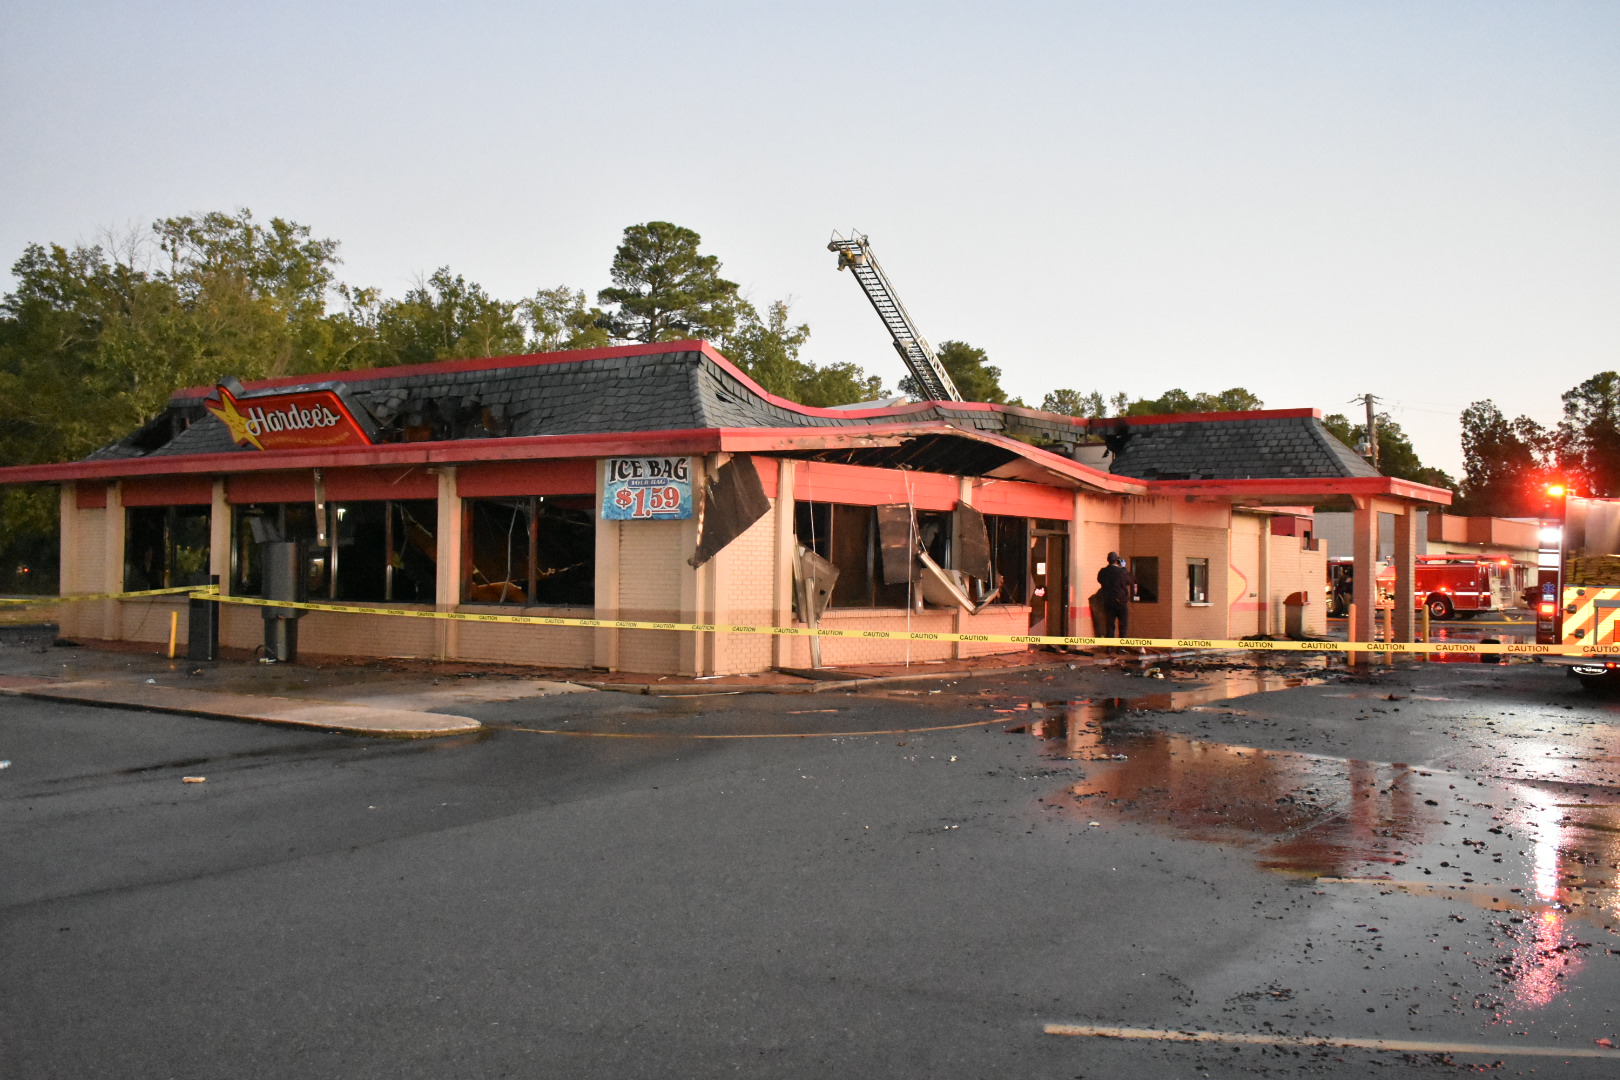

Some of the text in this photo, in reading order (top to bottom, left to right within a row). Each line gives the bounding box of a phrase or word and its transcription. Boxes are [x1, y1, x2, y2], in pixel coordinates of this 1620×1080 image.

[245, 403, 341, 436] Hardee's
[610, 458, 688, 482] ICE BAG
[615, 486, 680, 516] $1.59
[1177, 640, 1212, 648] CAUTION
[1366, 643, 1405, 651] CAUTION
